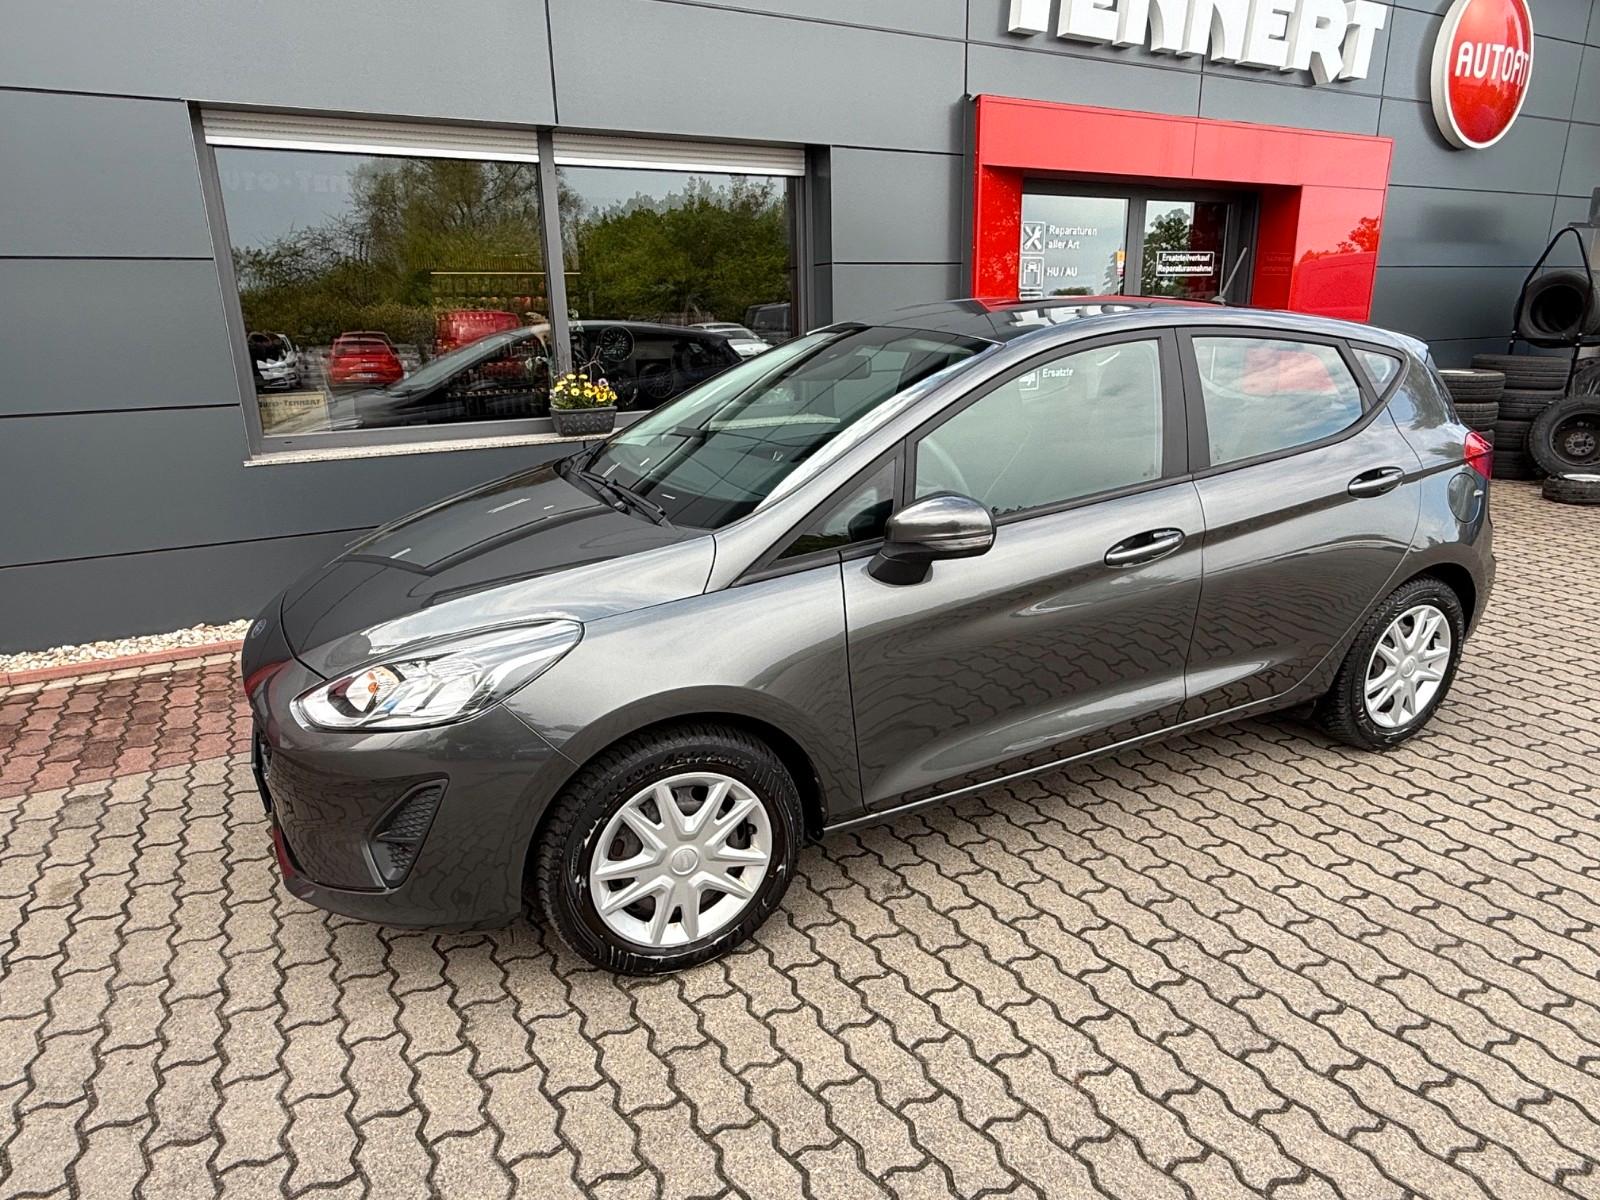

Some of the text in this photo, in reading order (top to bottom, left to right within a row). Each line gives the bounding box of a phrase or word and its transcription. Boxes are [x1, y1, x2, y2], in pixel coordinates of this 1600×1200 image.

[1455, 41, 1529, 87] AUTOFIT
[1049, 224, 1098, 238] Reparaturen
[1048, 239, 1080, 249] aller Art
[1046, 266, 1059, 277] HU
[1065, 266, 1078, 277] AU
